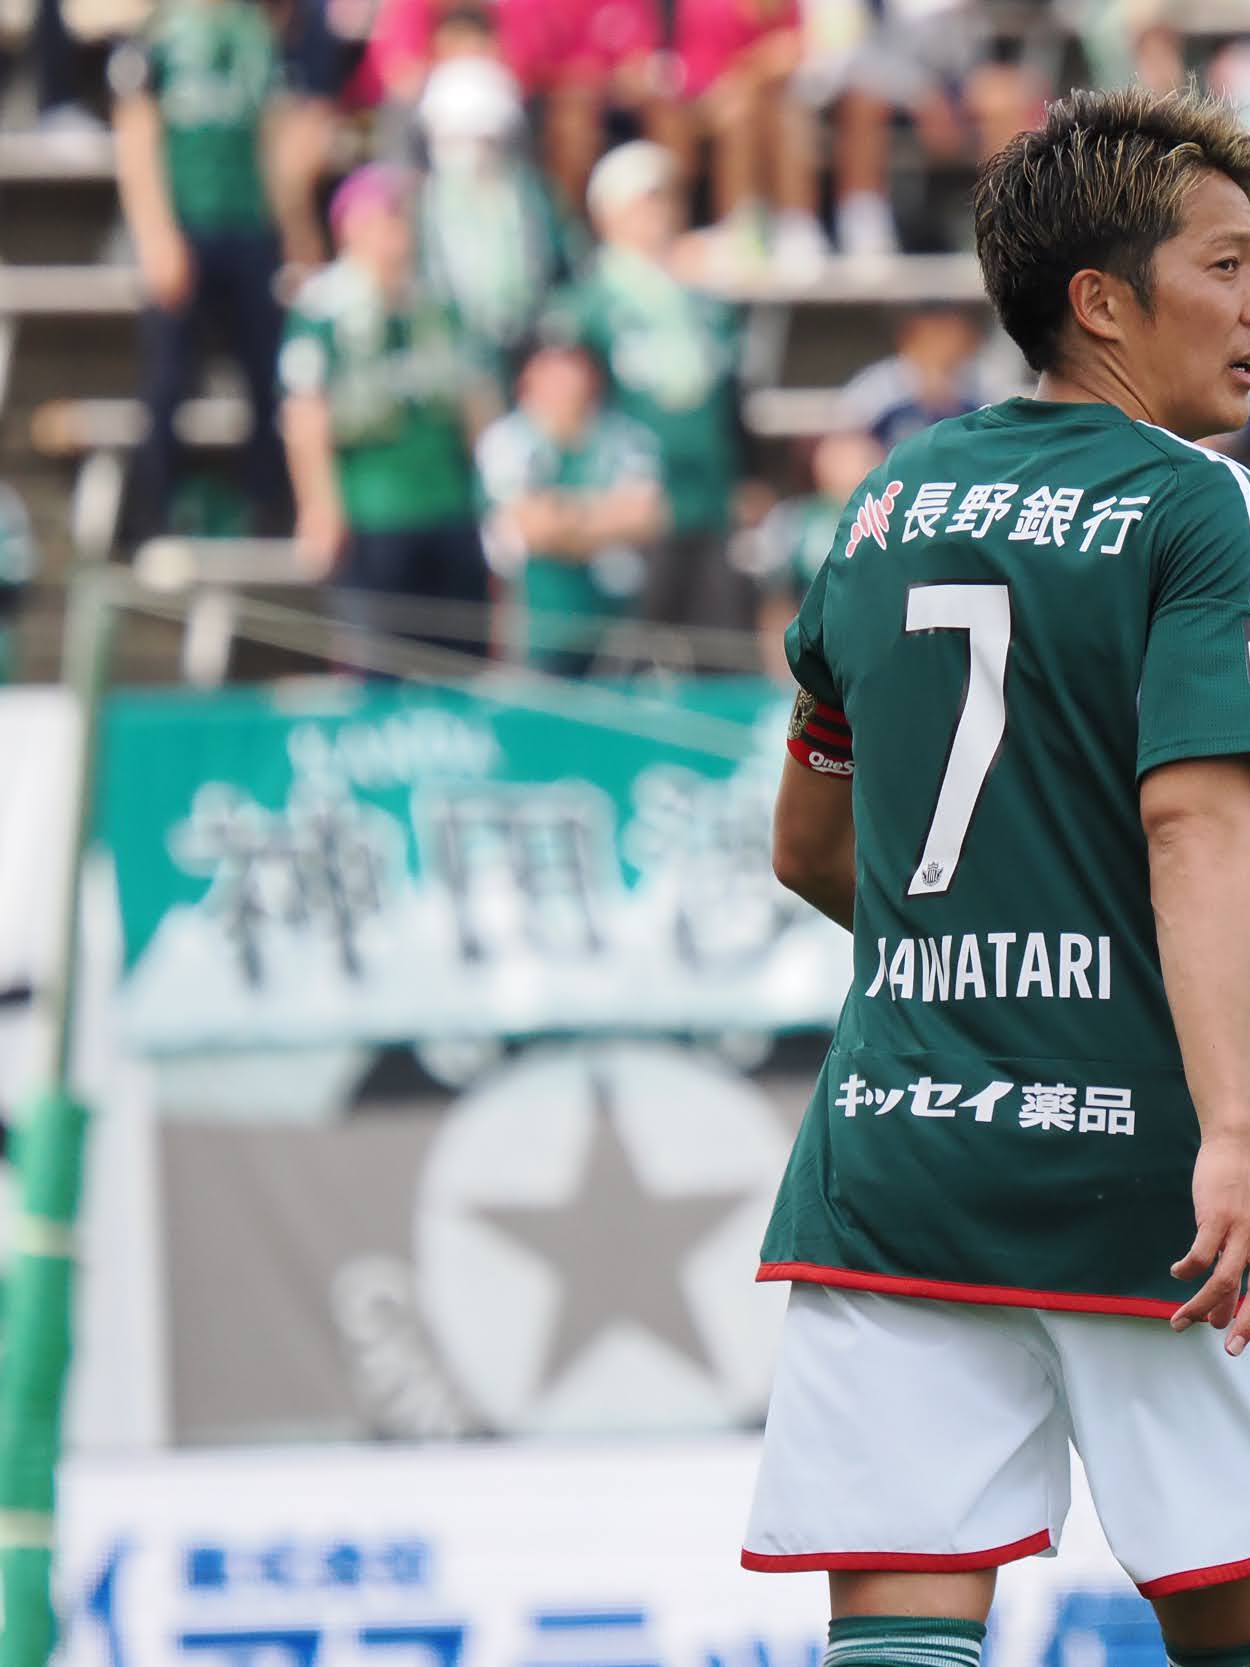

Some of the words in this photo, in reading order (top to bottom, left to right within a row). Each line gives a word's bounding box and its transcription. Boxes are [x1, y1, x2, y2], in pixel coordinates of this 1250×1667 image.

[902, 482, 1151, 555] 長野銀行
[906, 584, 1011, 896] 7
[834, 1073, 1136, 1136] キッセイ薬品
